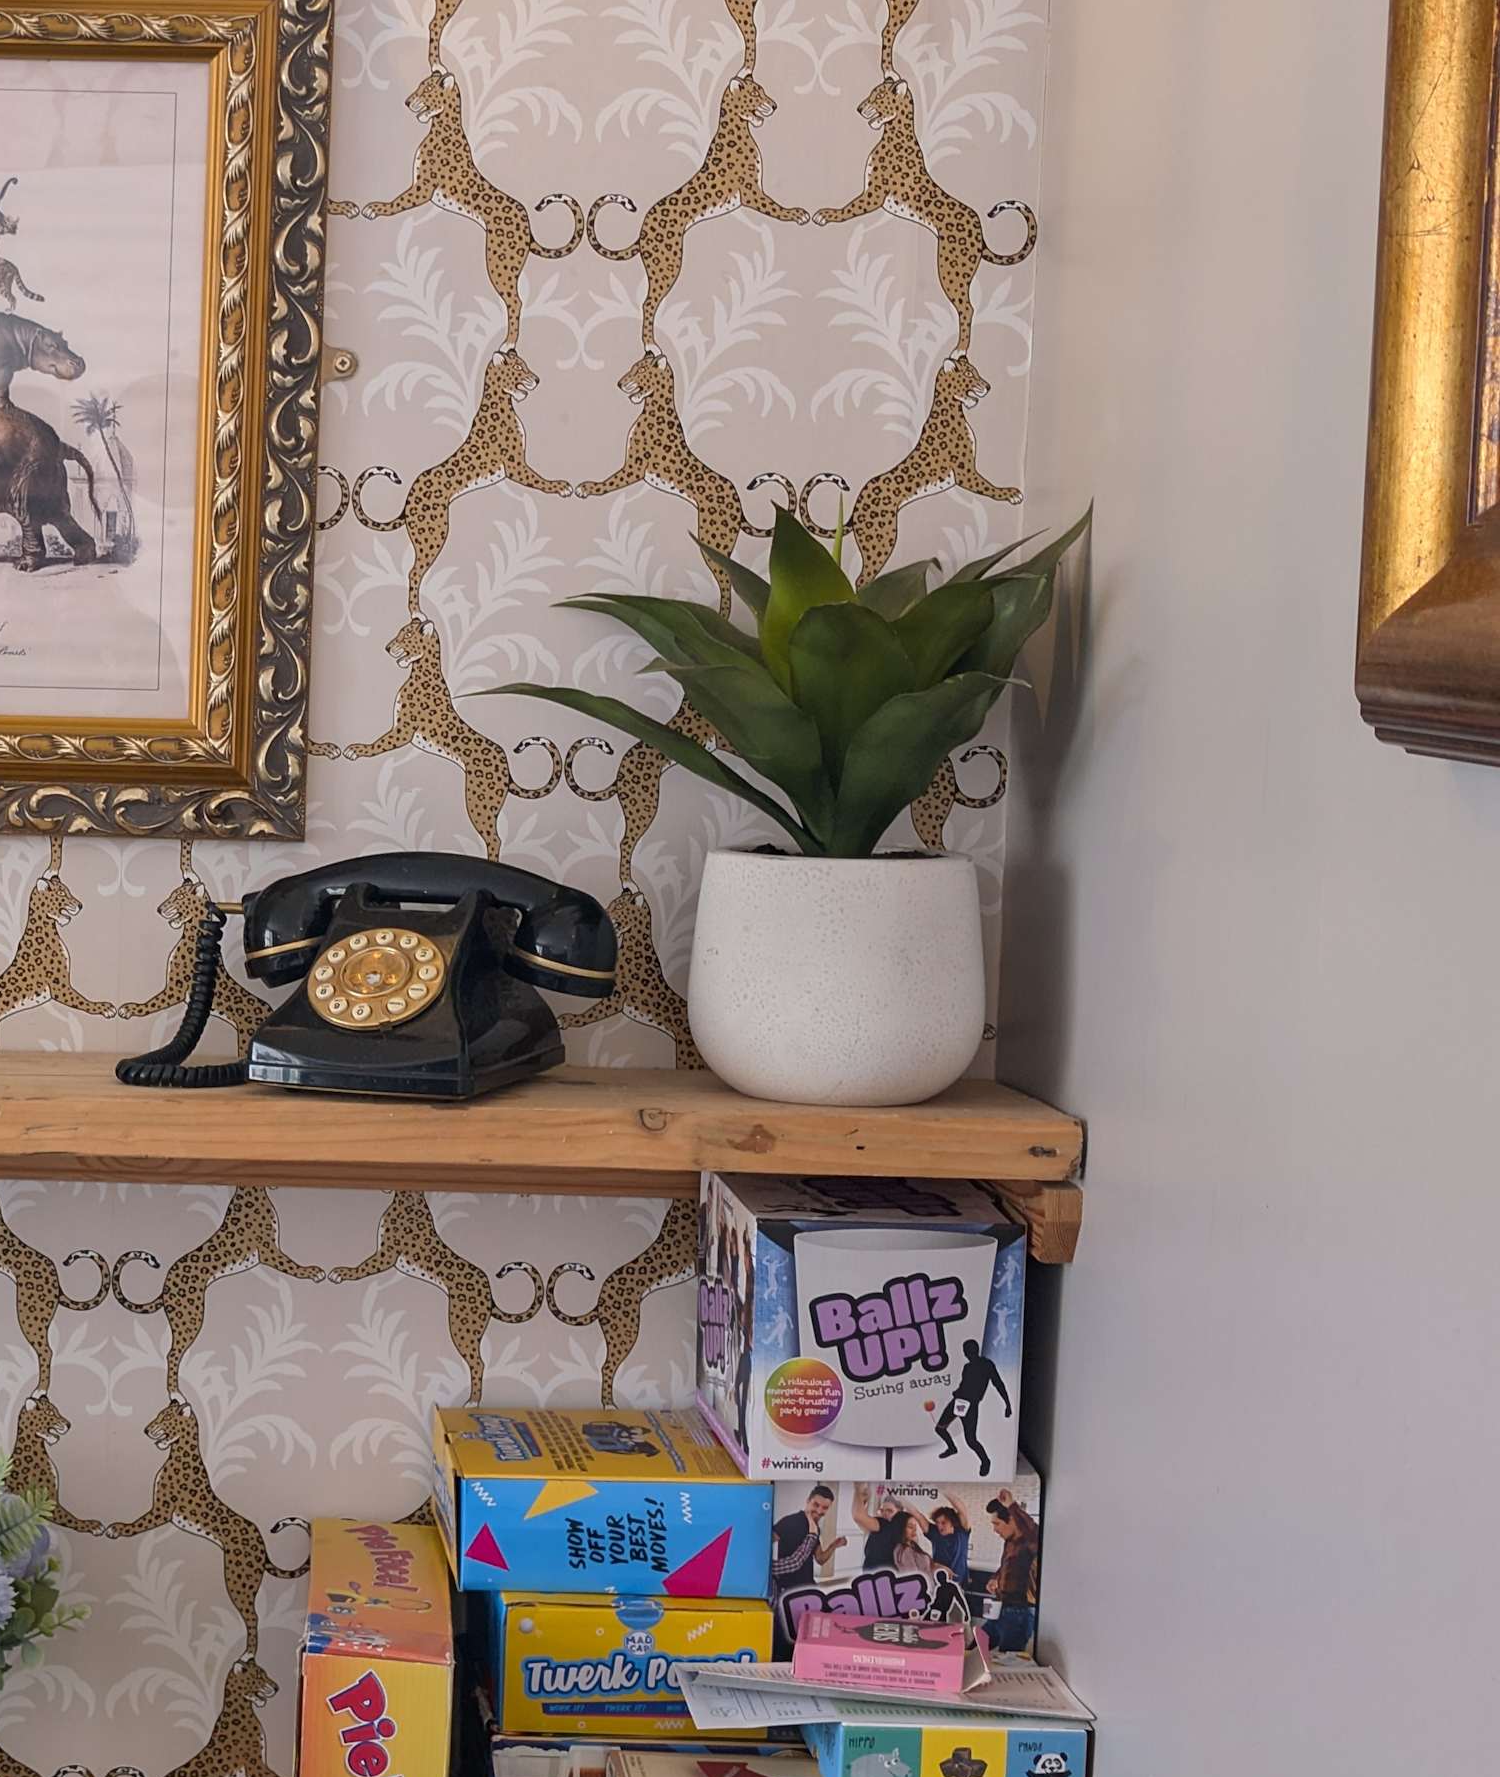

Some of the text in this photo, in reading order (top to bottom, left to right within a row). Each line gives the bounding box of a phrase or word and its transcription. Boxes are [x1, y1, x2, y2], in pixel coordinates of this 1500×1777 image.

[811, 1275, 966, 1346] Ballz
[842, 1321, 947, 1378] UP!
[806, 1386, 822, 1395] and
[825, 1387, 841, 1396] fun
[853, 1374, 952, 1401] Swing away
[780, 1407, 802, 1417] party
[762, 1456, 824, 1472] #winning
[876, 1484, 938, 1499] #winning
[566, 1517, 586, 1570] SHOW
[588, 1526, 605, 1564] OFF
[608, 1514, 627, 1565] YOUR
[627, 1513, 648, 1563] BEST
[646, 1497, 670, 1574] MOVES!
[625, 1635, 652, 1647] MAD
[629, 1643, 650, 1653] CAP
[527, 1655, 639, 1693] Twerk
[327, 1669, 398, 1777] Pie
[848, 1736, 876, 1749] HIPPO
[1018, 1741, 1043, 1753] PANDA
